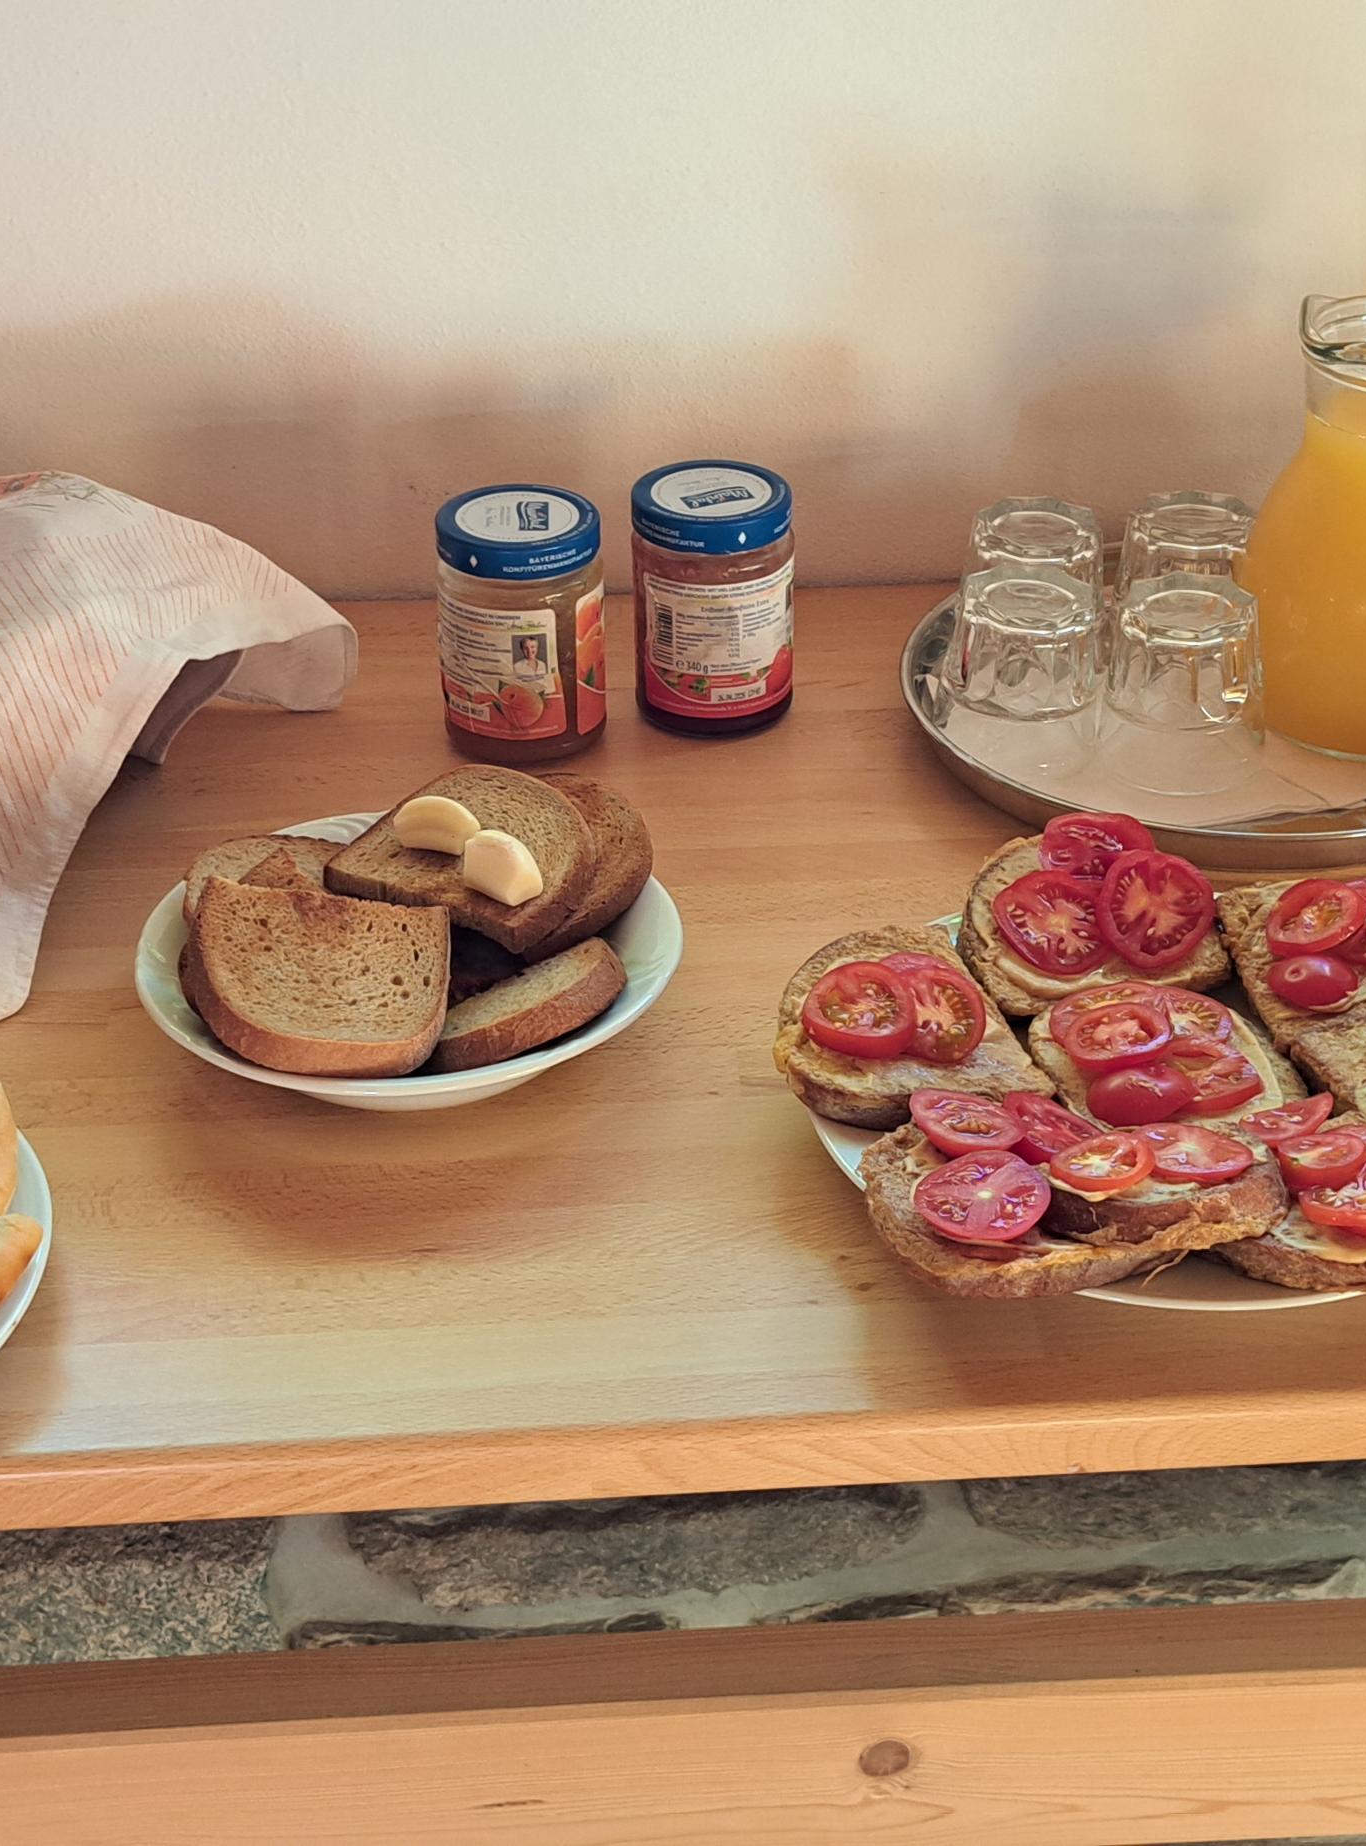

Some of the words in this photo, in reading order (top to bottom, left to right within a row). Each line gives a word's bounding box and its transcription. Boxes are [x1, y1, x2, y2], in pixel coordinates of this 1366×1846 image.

[528, 549, 577, 564] BAYERISCHE
[685, 660, 702, 672] 340
[702, 664, 709, 675] g
